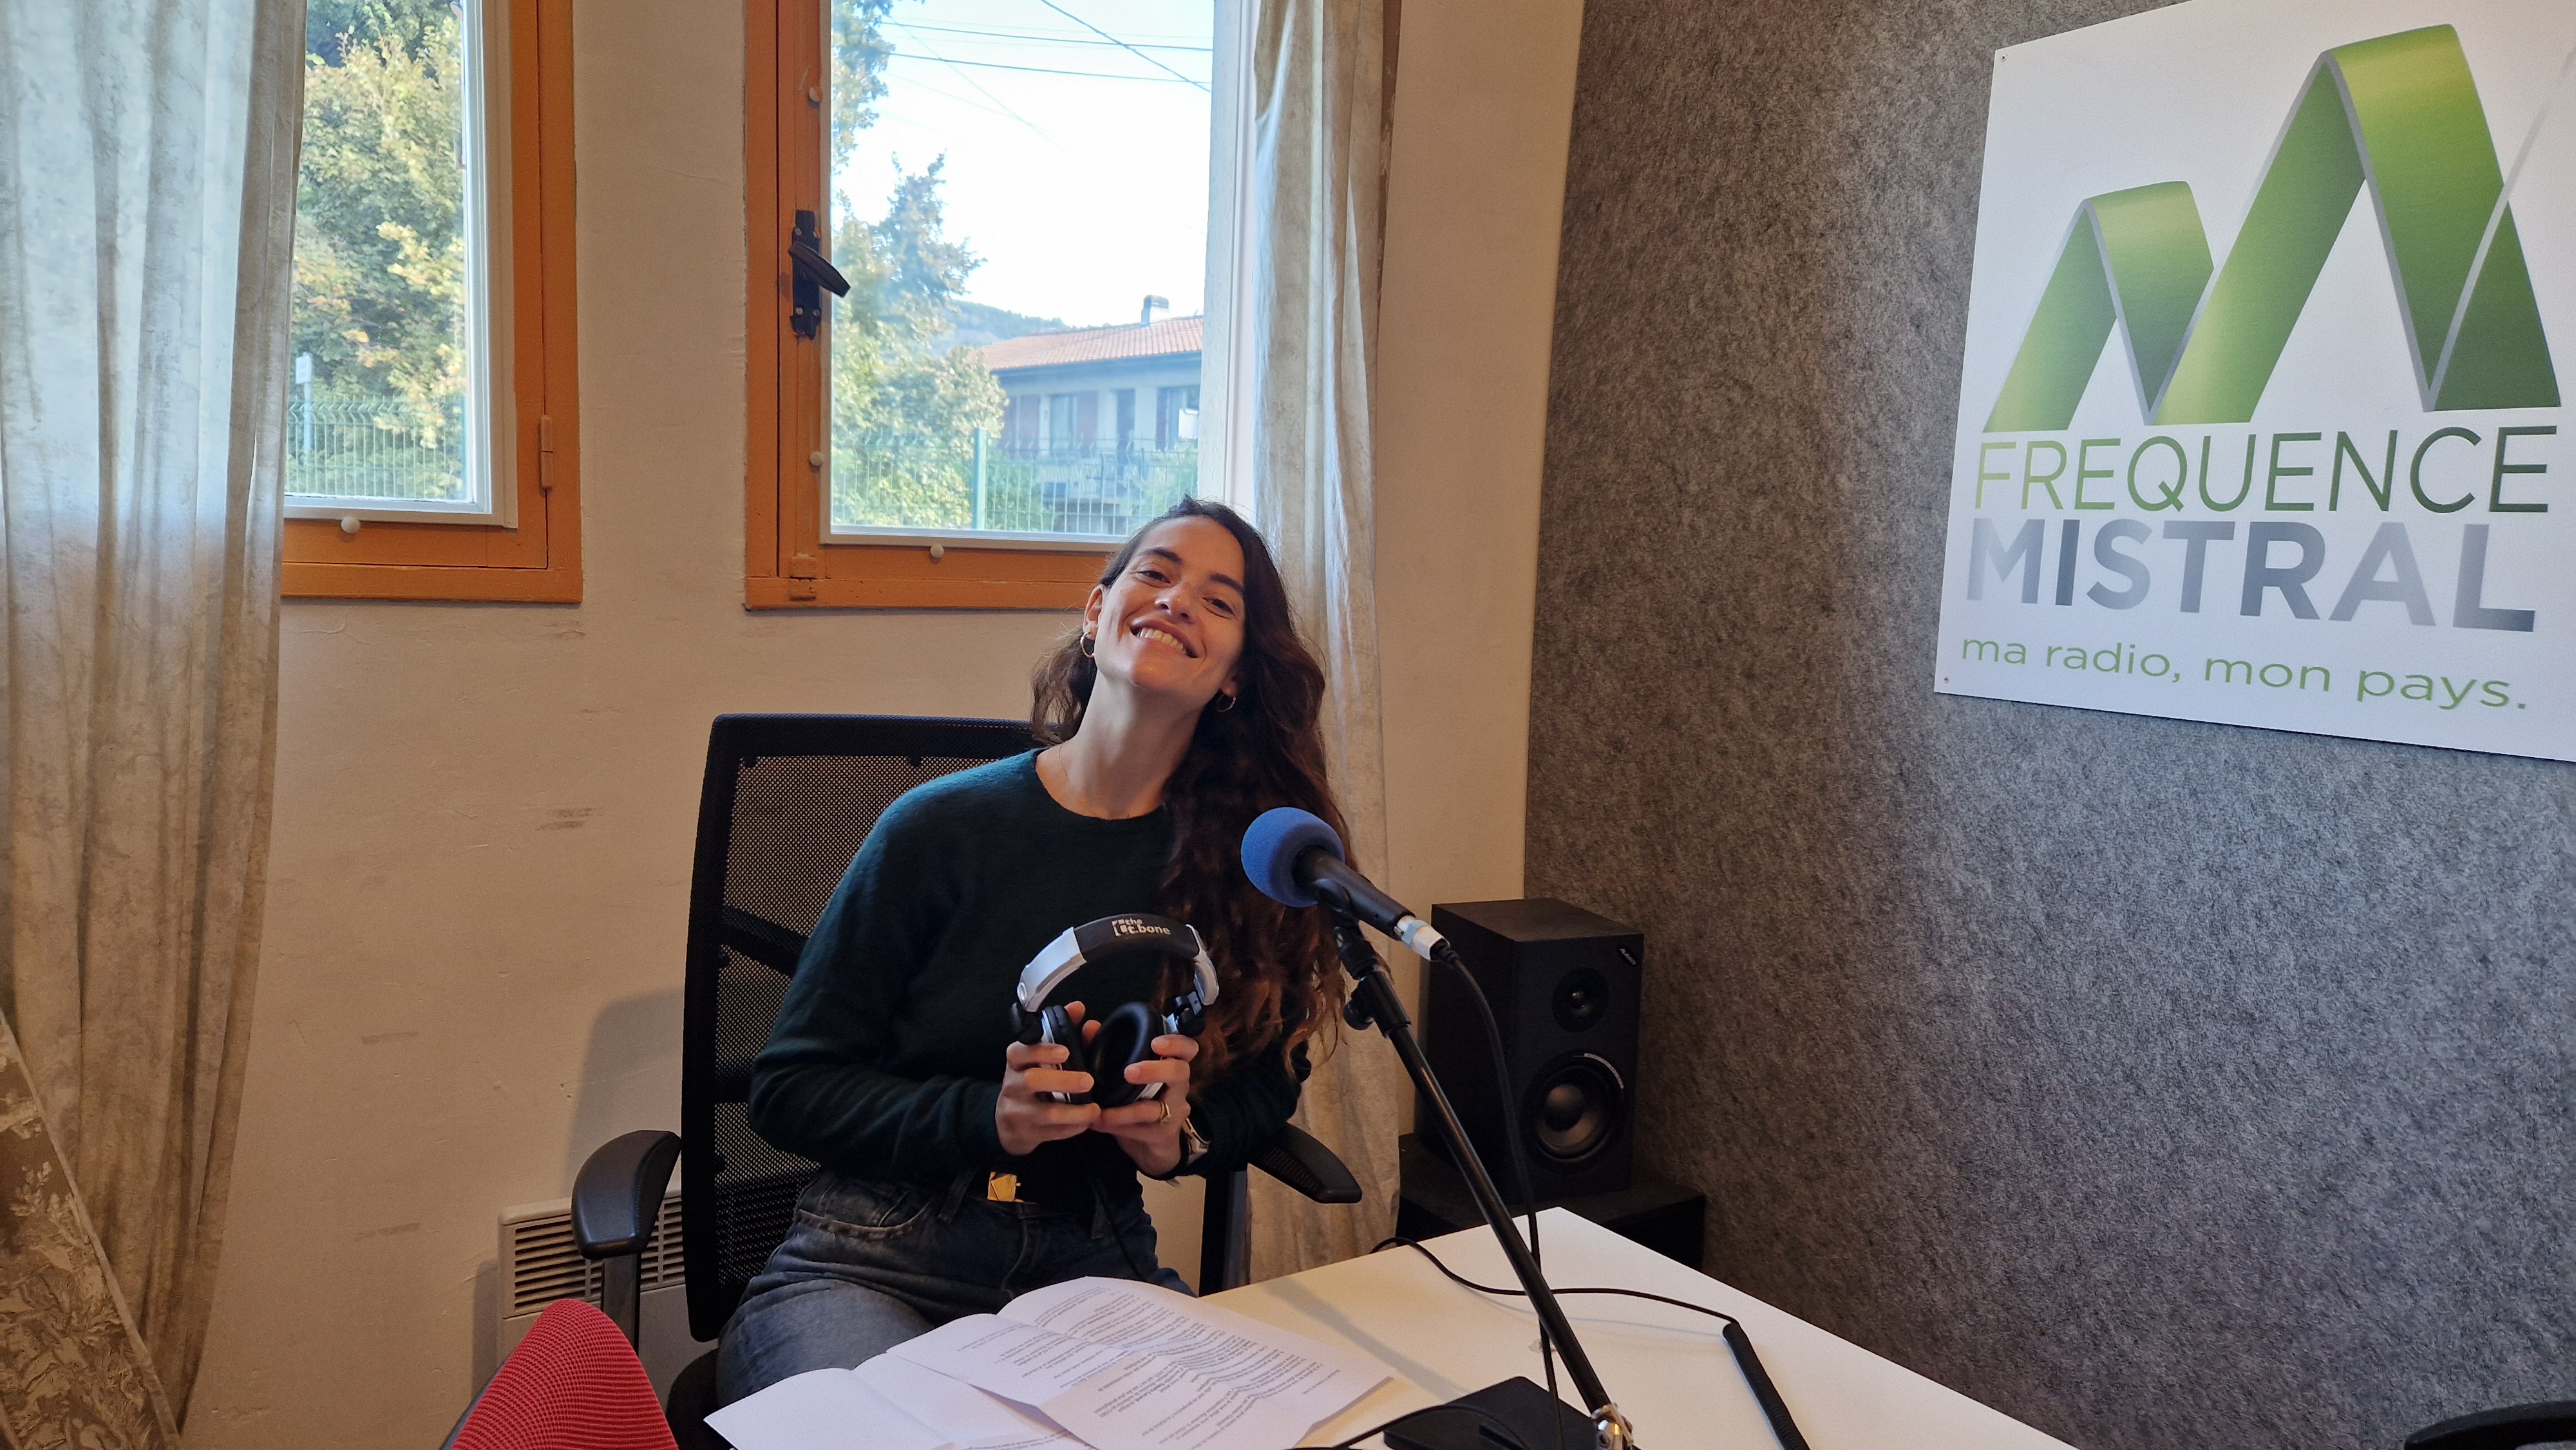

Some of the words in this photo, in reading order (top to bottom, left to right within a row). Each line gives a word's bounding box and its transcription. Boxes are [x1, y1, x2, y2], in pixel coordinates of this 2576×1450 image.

[1975, 425, 2557, 514] FREQUENCE
[1966, 518, 2536, 633] MISTRAL
[1962, 638, 2027, 664] ma
[2045, 642, 2181, 683] radio,
[2204, 657, 2331, 692] mon
[2356, 670, 2526, 710] pays.
[1127, 923, 1171, 935] t.bone
